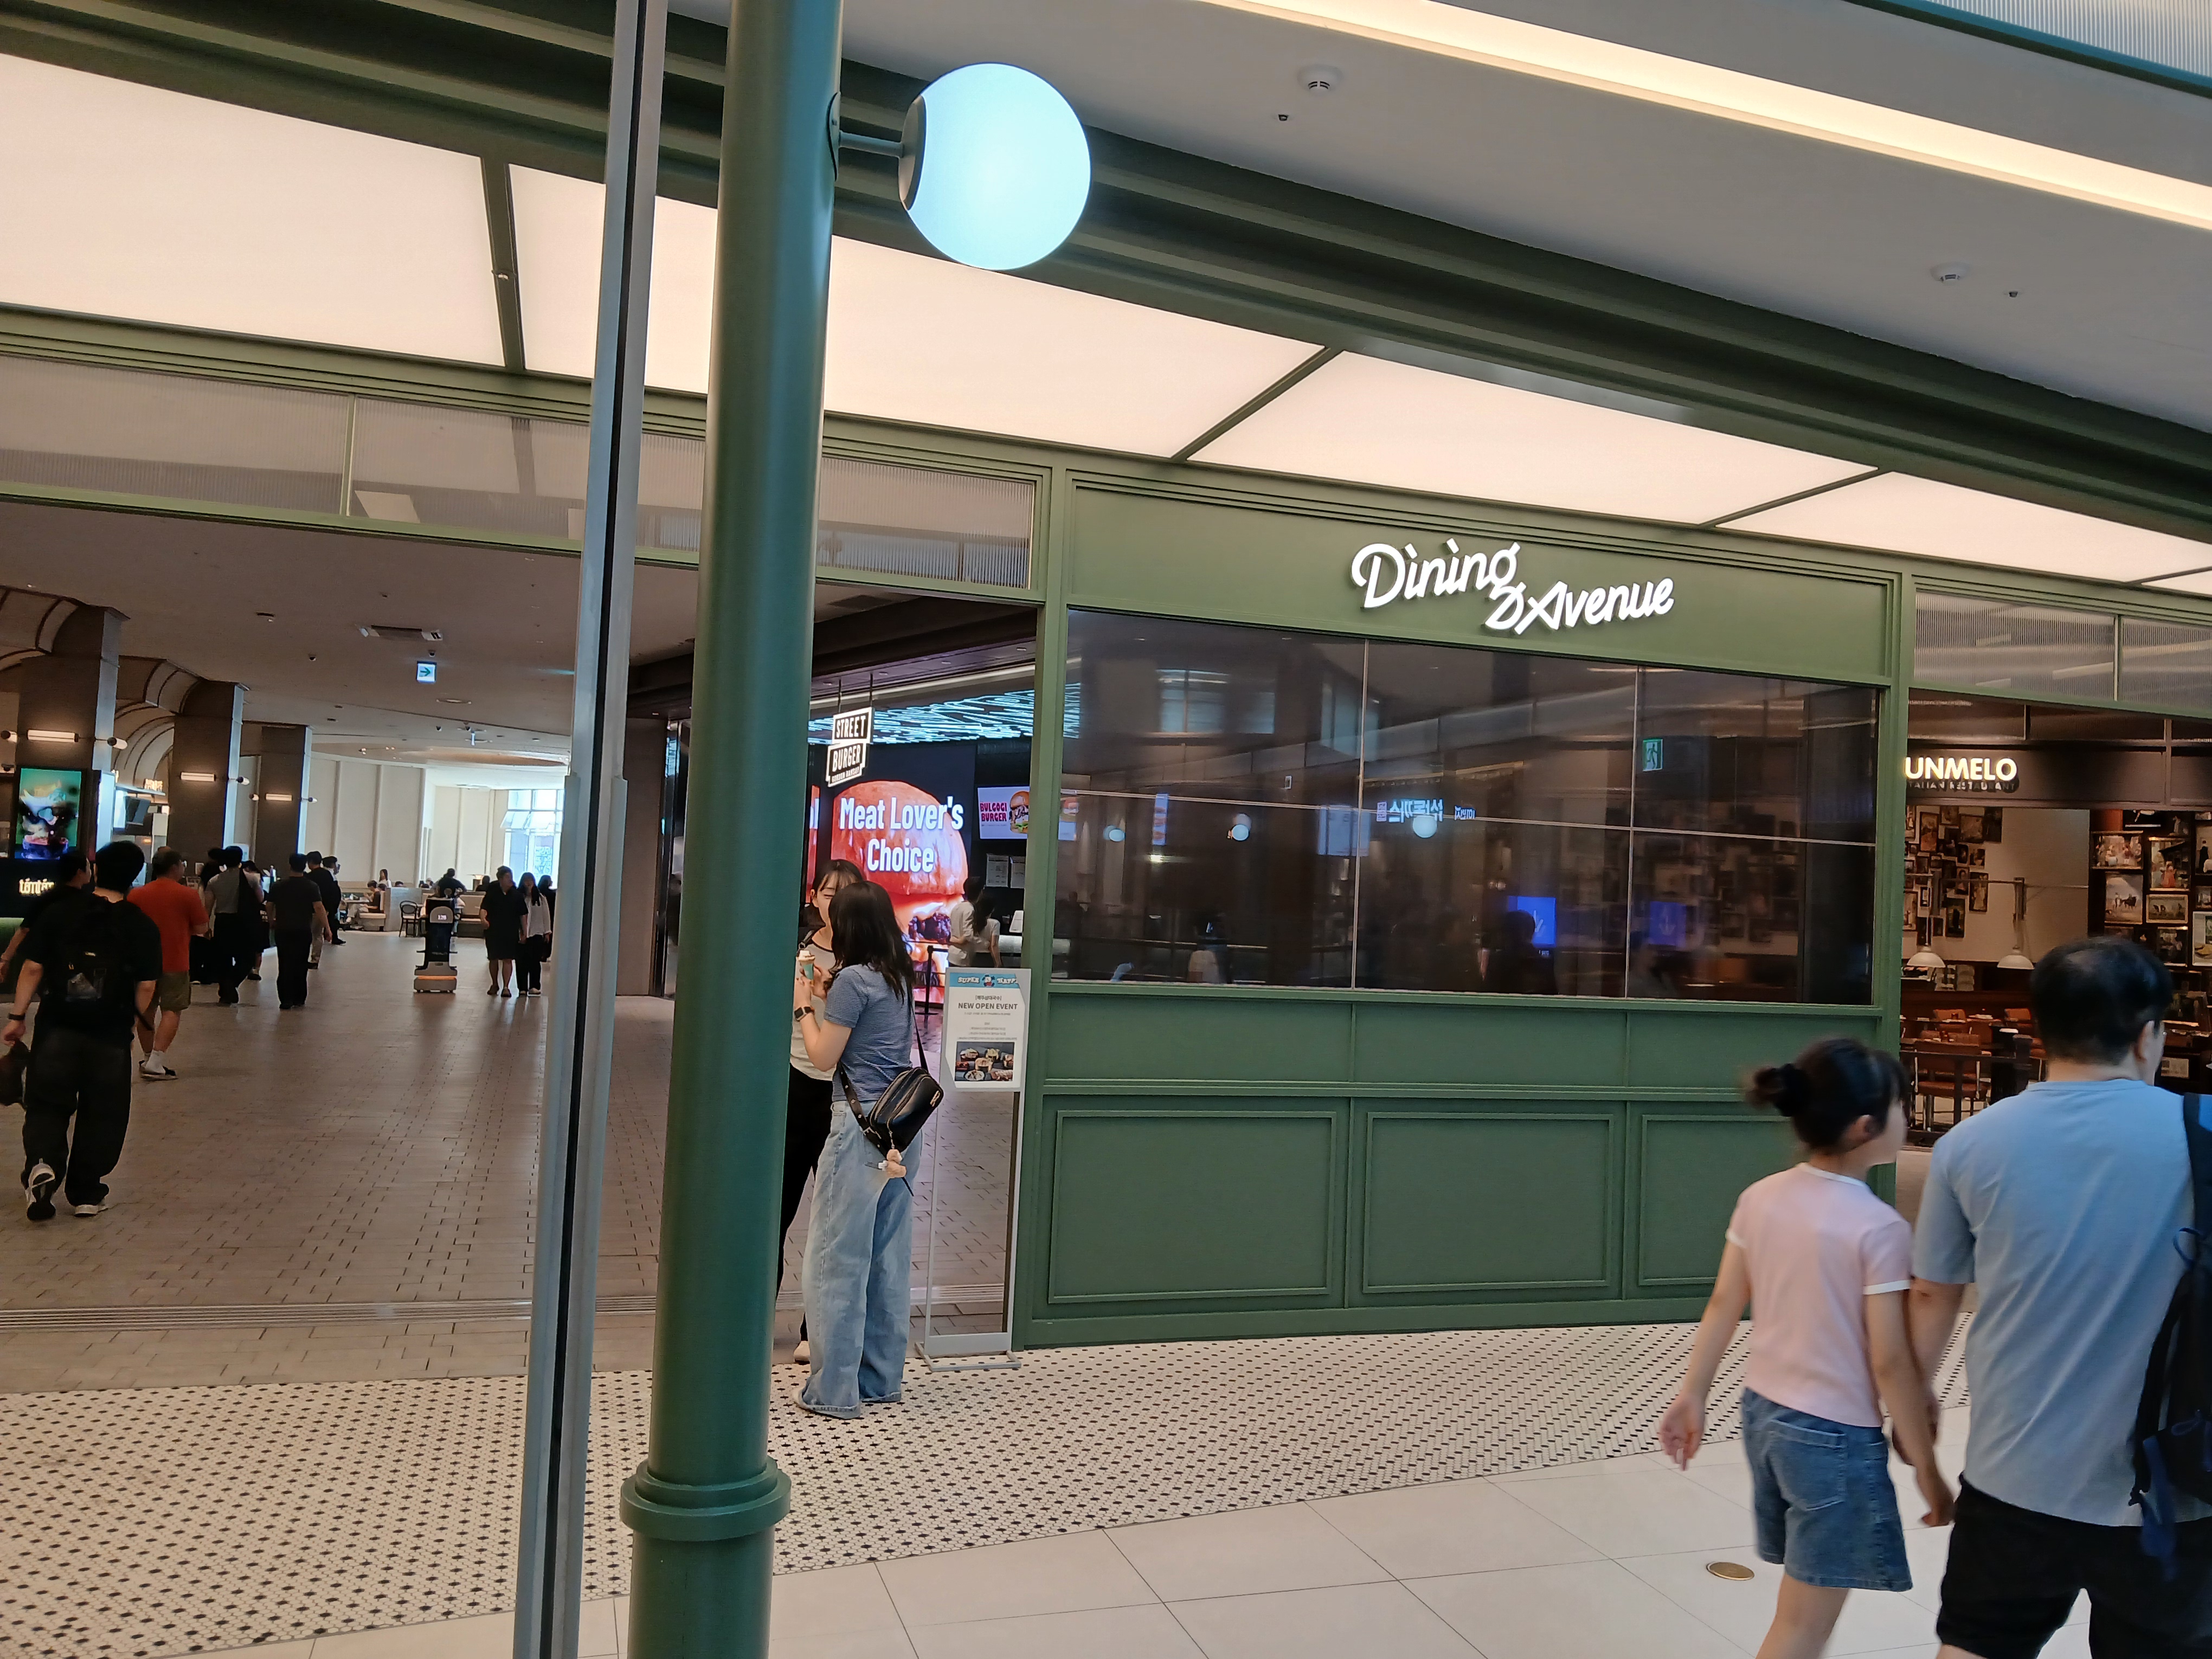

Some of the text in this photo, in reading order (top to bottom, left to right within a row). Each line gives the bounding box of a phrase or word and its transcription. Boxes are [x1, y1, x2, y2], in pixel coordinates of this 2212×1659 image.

[1351, 538, 1521, 608] Dining
[837, 715, 866, 738] STREET
[832, 744, 861, 772] BURGER
[1905, 757, 2017, 781] UNMELO
[839, 797, 885, 830] Meat
[890, 796, 963, 830] Lover's
[980, 802, 1007, 812] BULGOGI
[981, 813, 1007, 822] BURGER
[867, 838, 935, 872] Choice
